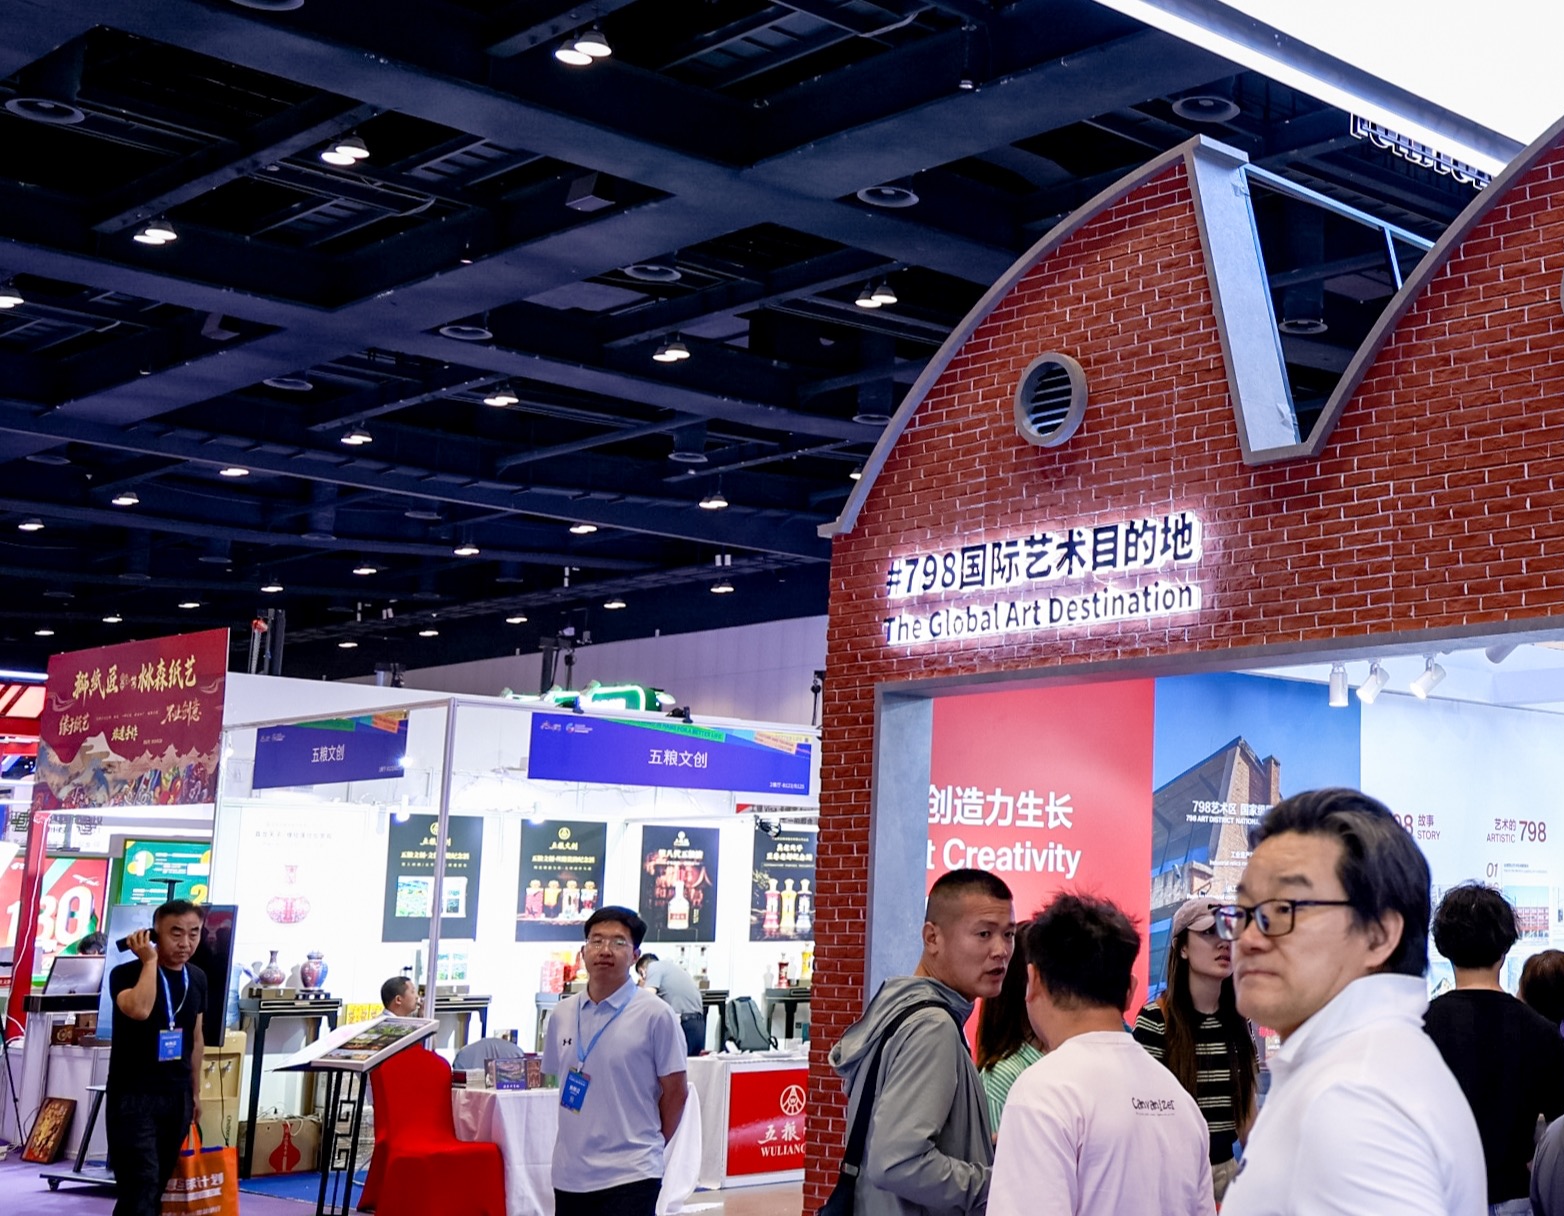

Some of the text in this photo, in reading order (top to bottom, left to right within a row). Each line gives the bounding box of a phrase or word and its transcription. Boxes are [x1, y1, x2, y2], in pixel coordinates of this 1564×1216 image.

[886, 512, 1193, 595] #798国际艺术目的地
[884, 581, 1193, 643] The Global Art Destination
[311, 744, 345, 763] 五粮文创
[648, 748, 708, 769] 五粮文创
[928, 784, 1074, 830] 创造力生长
[1192, 800, 1237, 815] 798艺术区
[1418, 814, 1434, 828] 故事
[1494, 818, 1516, 832] 艺术的
[1417, 830, 1441, 841] STORY
[1486, 833, 1516, 844] ARTISTIC
[1519, 820, 1547, 843] 798
[943, 838, 1082, 879] Creativity
[1486, 862, 1498, 878] 01
[757, 1121, 807, 1145] 五粮
